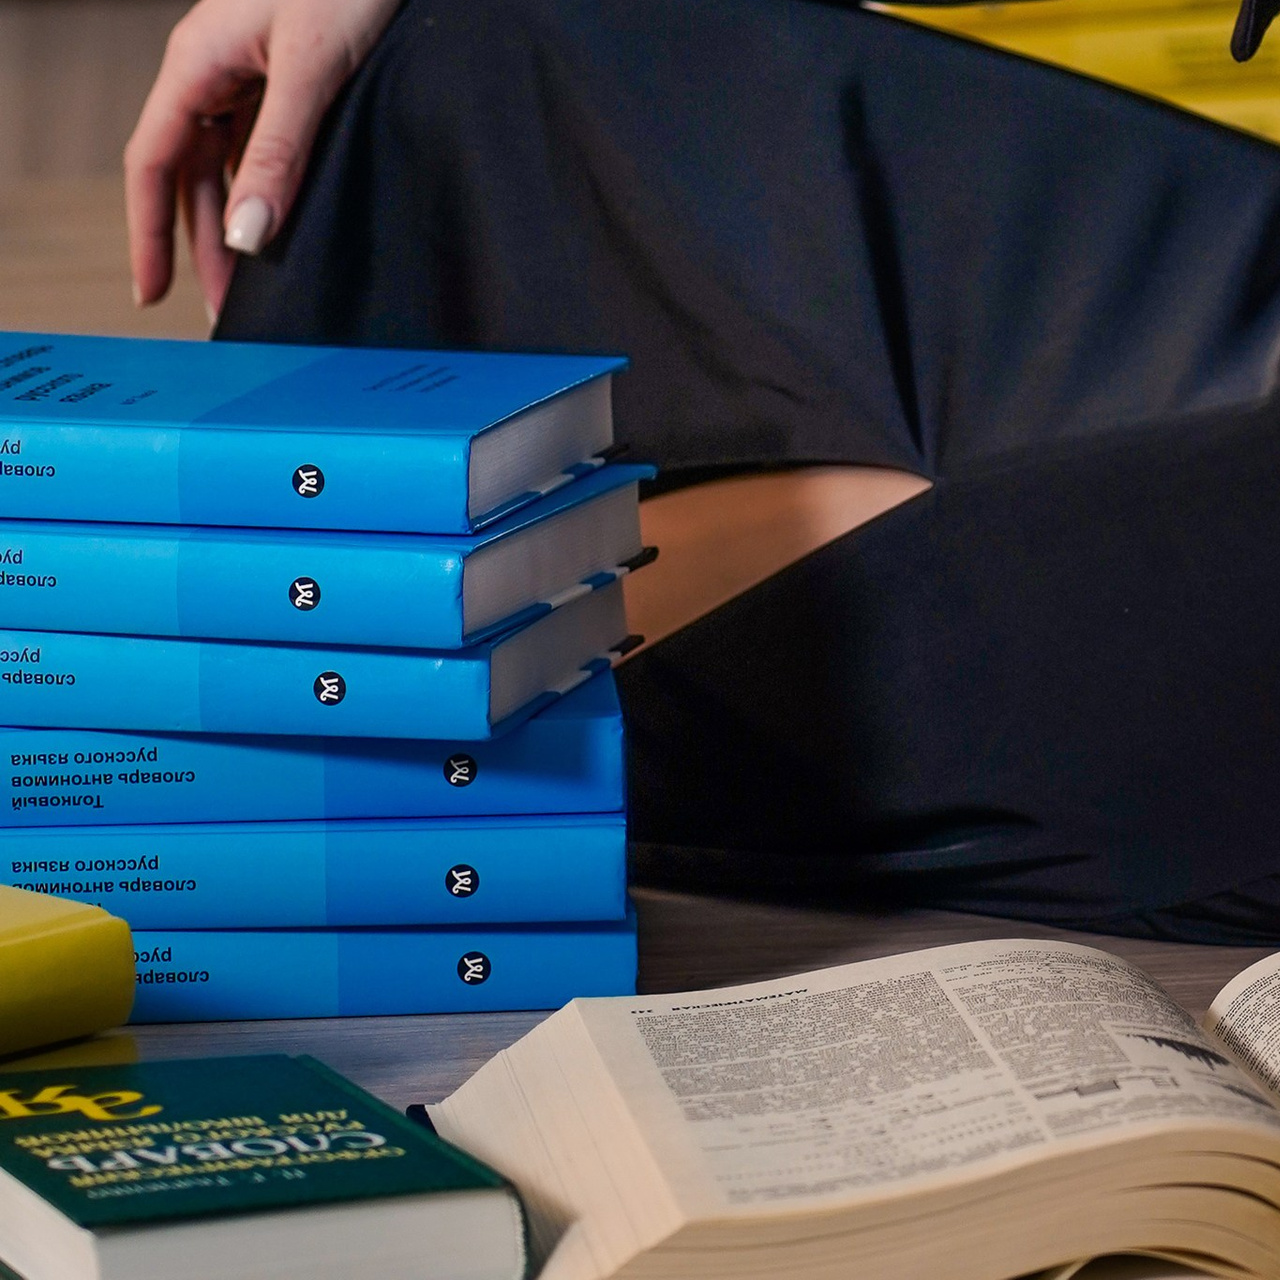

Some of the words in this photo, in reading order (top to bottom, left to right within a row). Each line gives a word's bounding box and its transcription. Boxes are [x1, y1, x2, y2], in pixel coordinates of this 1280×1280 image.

[1, 669, 76, 686] словарь
[10, 753, 69, 766] языка
[73, 746, 158, 764] русского
[11, 773, 114, 788] антонимов
[117, 768, 196, 784] словарь
[11, 794, 105, 811] Толковый
[11, 860, 70, 874] языка
[74, 855, 159, 872] русского
[118, 876, 197, 893] словарь
[47, 1130, 387, 1172] СЛОВАРЬ
